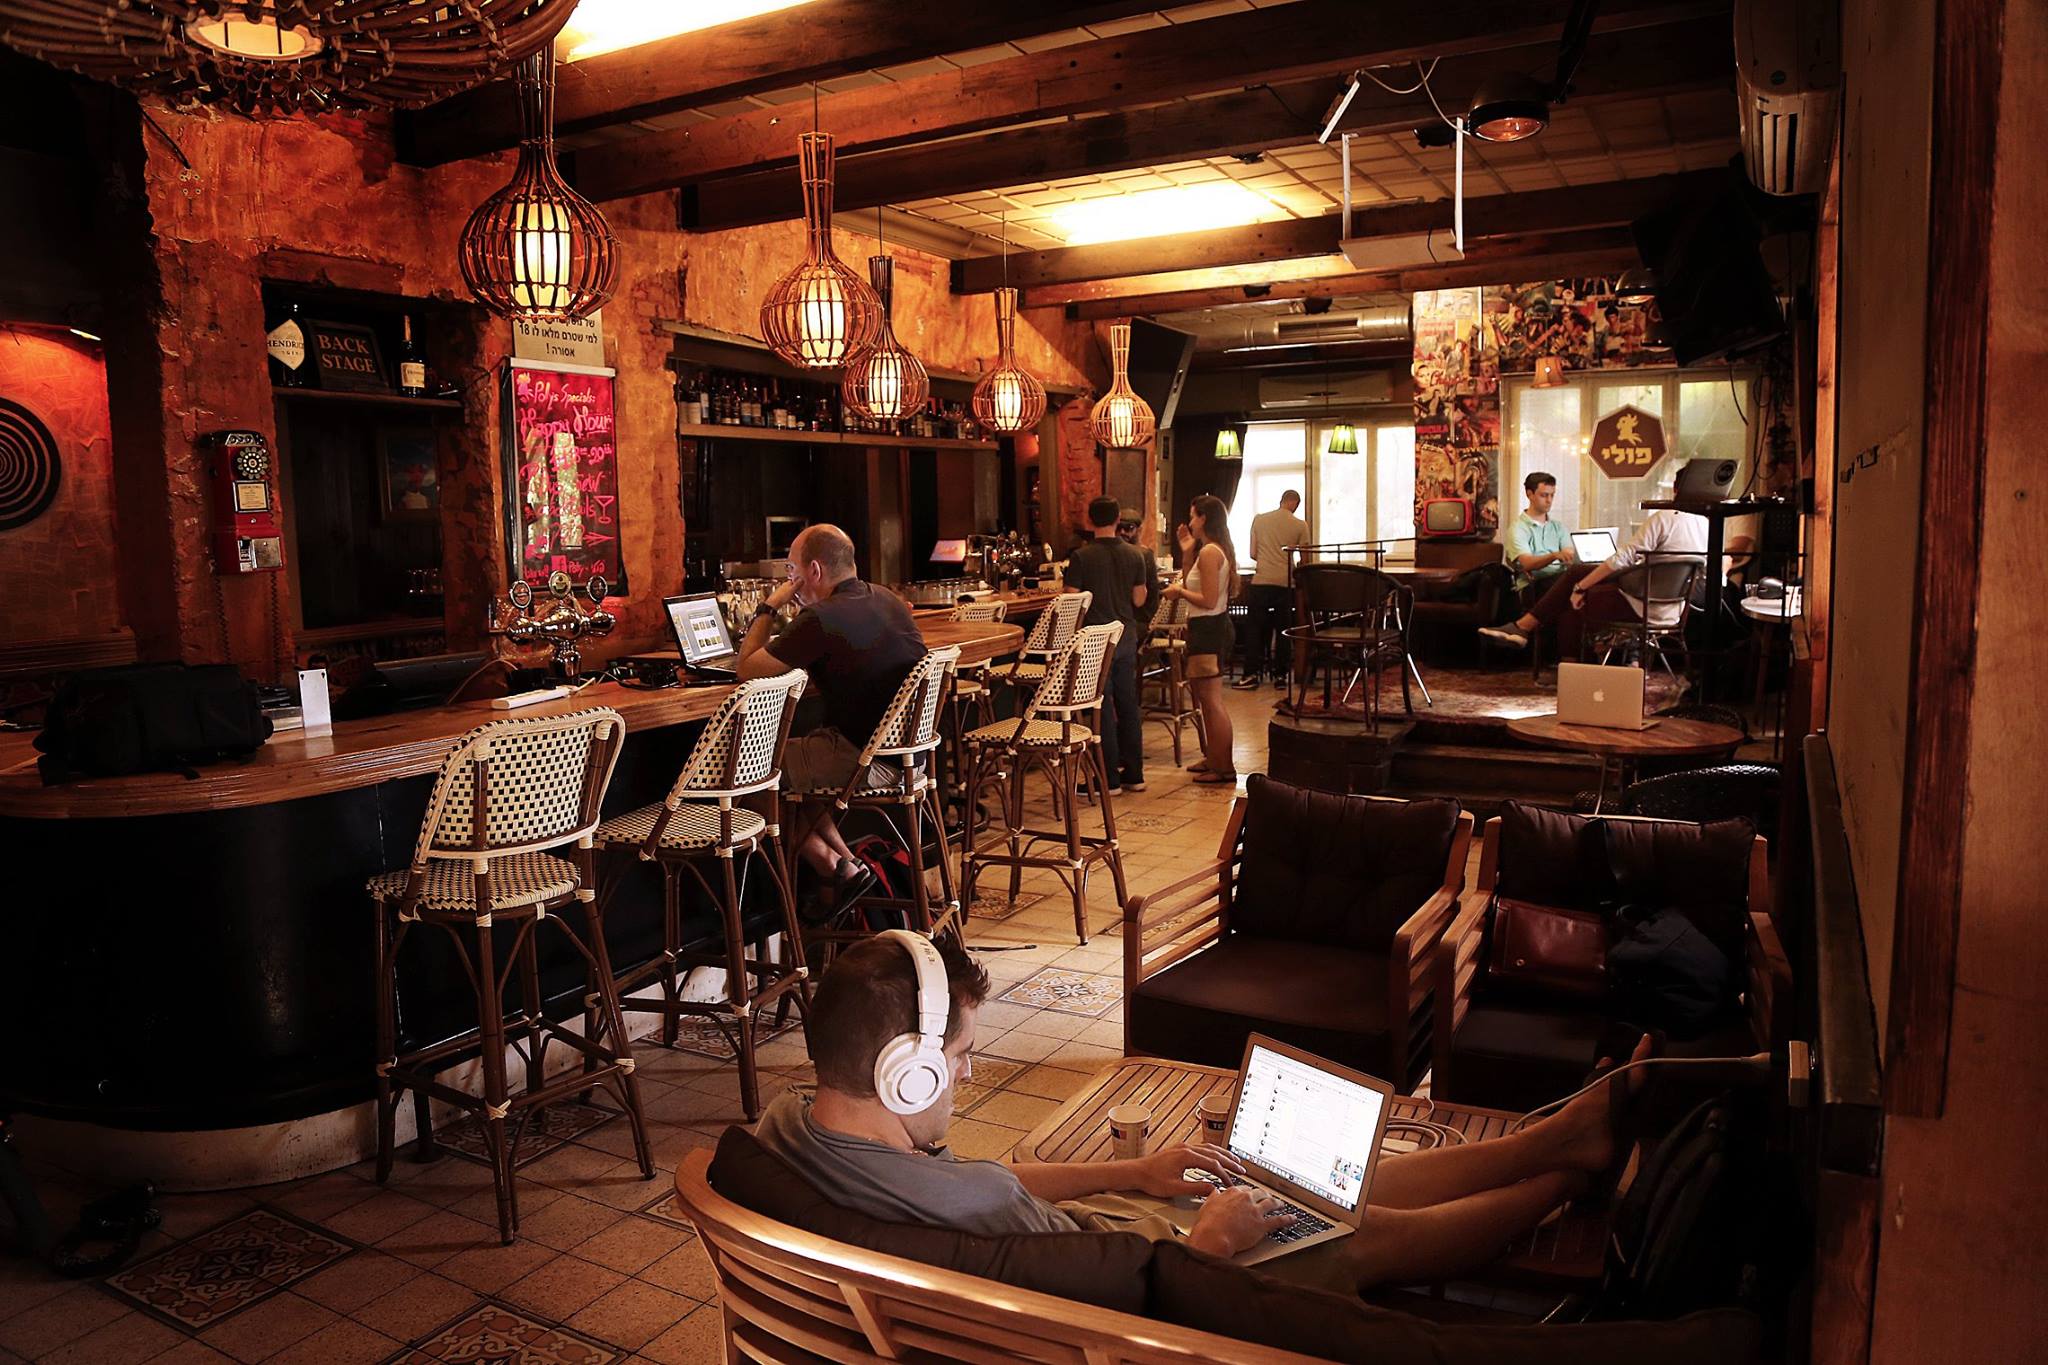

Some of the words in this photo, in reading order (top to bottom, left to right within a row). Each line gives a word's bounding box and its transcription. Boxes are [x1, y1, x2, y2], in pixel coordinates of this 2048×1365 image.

[519, 323, 530, 335] 18
[532, 325, 540, 336] לו
[541, 327, 560, 339] מלאו
[562, 330, 584, 342] שטרם
[585, 333, 598, 344] למי
[317, 335, 369, 354] BACK
[321, 354, 376, 373] STAGE
[1601, 443, 1653, 465] פולי
